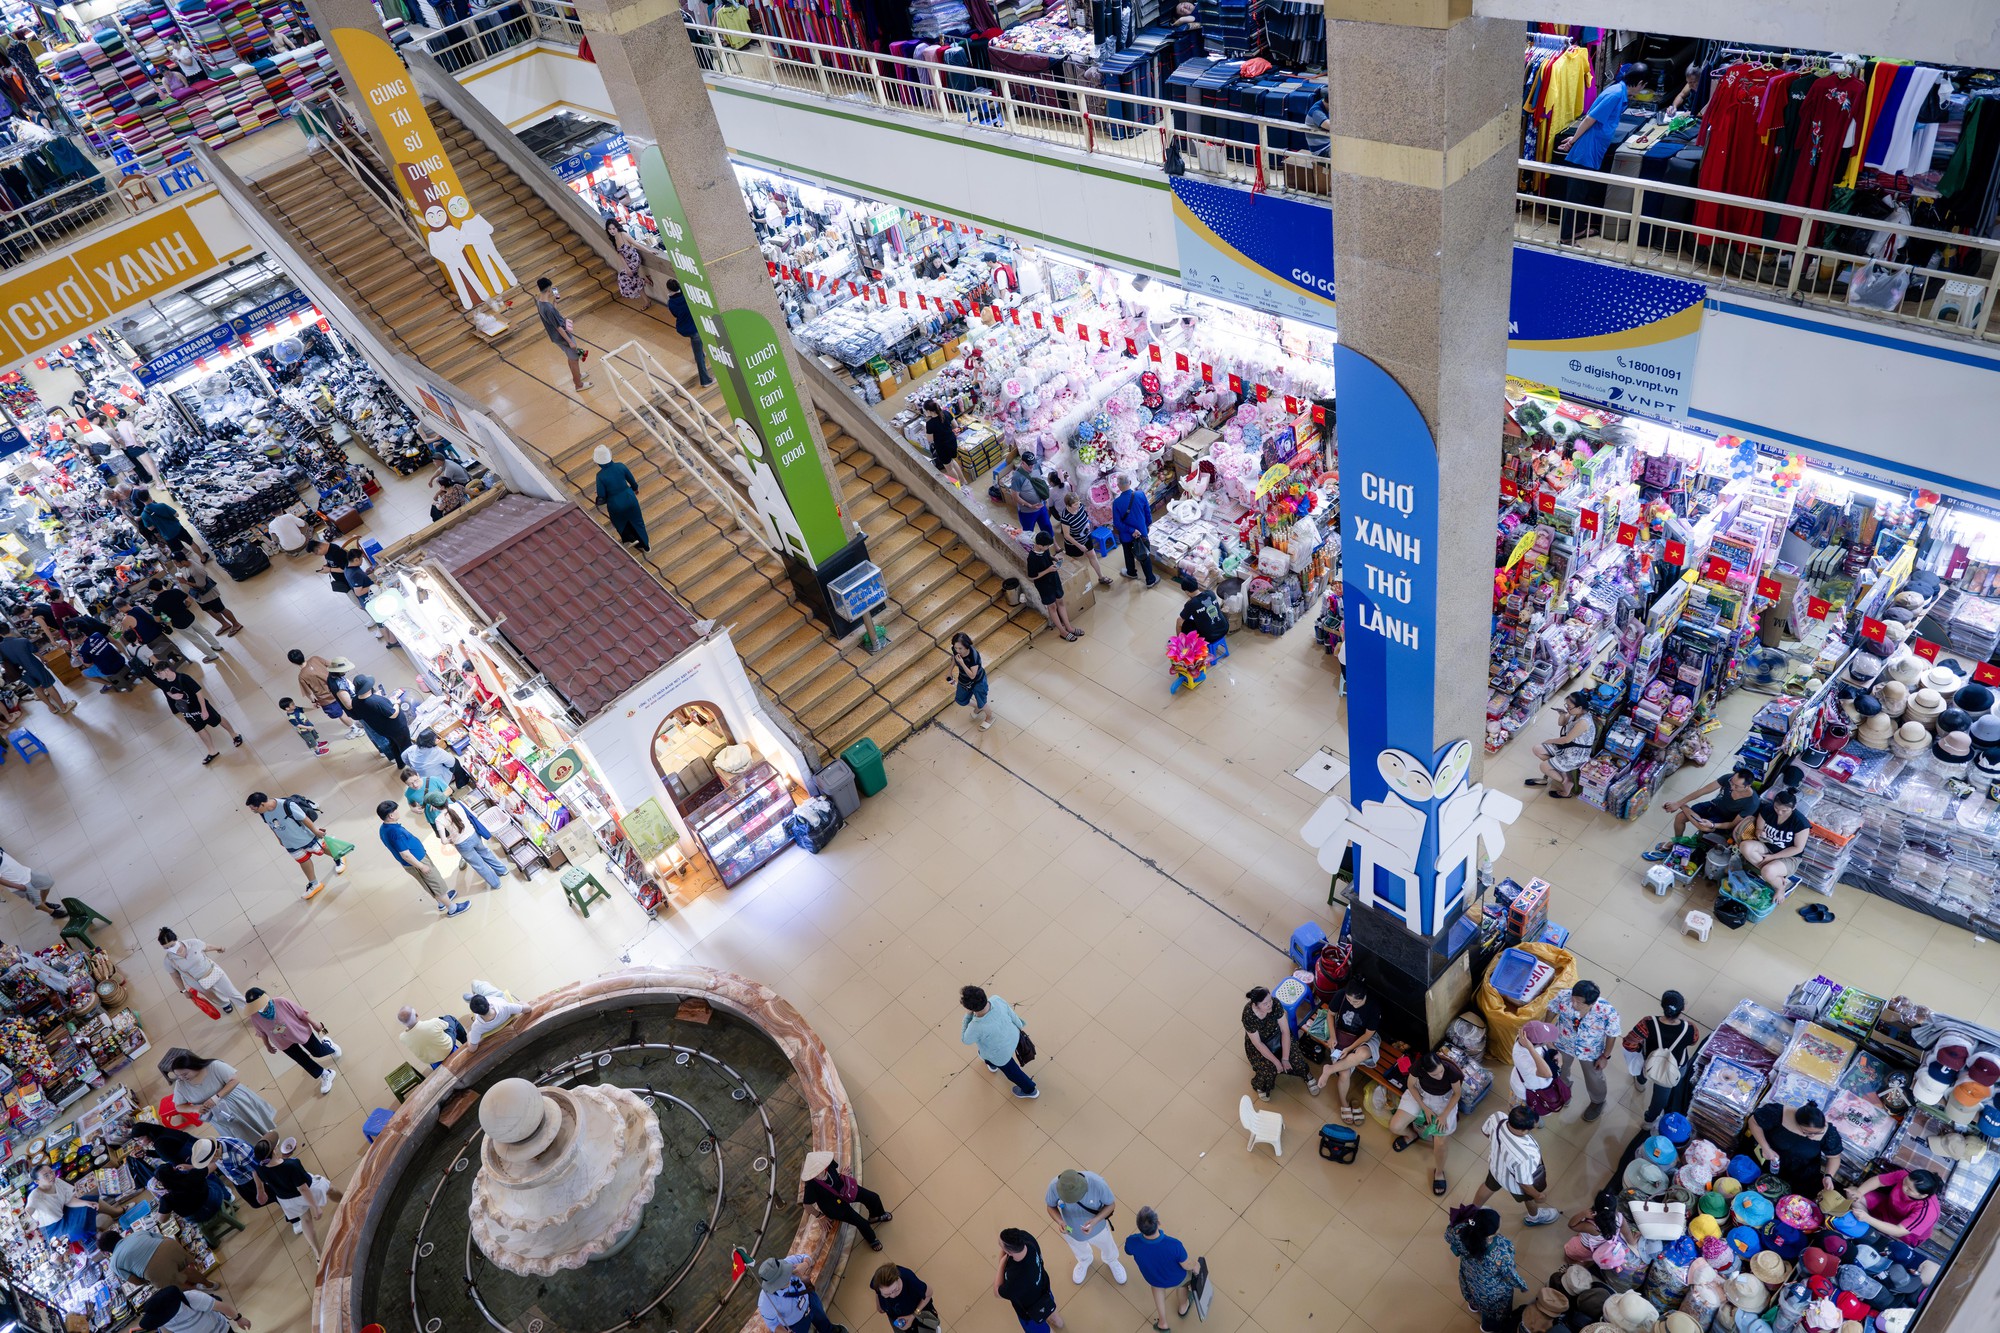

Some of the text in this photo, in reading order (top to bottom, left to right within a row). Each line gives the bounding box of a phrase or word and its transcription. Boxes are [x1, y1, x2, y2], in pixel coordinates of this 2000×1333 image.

[369, 79, 407, 106] CÙNG
[389, 107, 412, 128] TÁI
[403, 130, 423, 152] SỬ
[407, 154, 444, 181] DỤNG
[424, 180, 451, 203] NÀO
[661, 216, 683, 243] CẶP
[882, 218, 895, 229] EXIT
[670, 247, 704, 282] LỒNG,
[1292, 267, 1316, 287] GÓI
[8, 231, 198, 341] CHỢ XANH
[684, 282, 714, 309] QUEN
[248, 307, 269, 322] VINH
[700, 315, 720, 338] MÀ
[149, 352, 178, 371] TOÀN
[177, 335, 213, 356] THANH
[708, 344, 734, 369] CHẤT
[745, 343, 777, 370] Lunch
[754, 366, 777, 387] -box
[1584, 364, 1679, 396] digishop.vnpt.vn
[1628, 359, 1682, 381] 18001091
[1560, 376, 1582, 388] Thương
[1582, 380, 1595, 391] hiệu
[759, 386, 784, 410] fami
[1627, 393, 1677, 413] VNPT
[769, 407, 788, 426] -liar
[775, 426, 794, 448] and
[781, 441, 806, 468] good
[1361, 471, 1414, 519] CHỢ
[1354, 515, 1421, 565] XANH
[1364, 563, 1412, 604] THỞ
[1358, 602, 1419, 651] LÀNH
